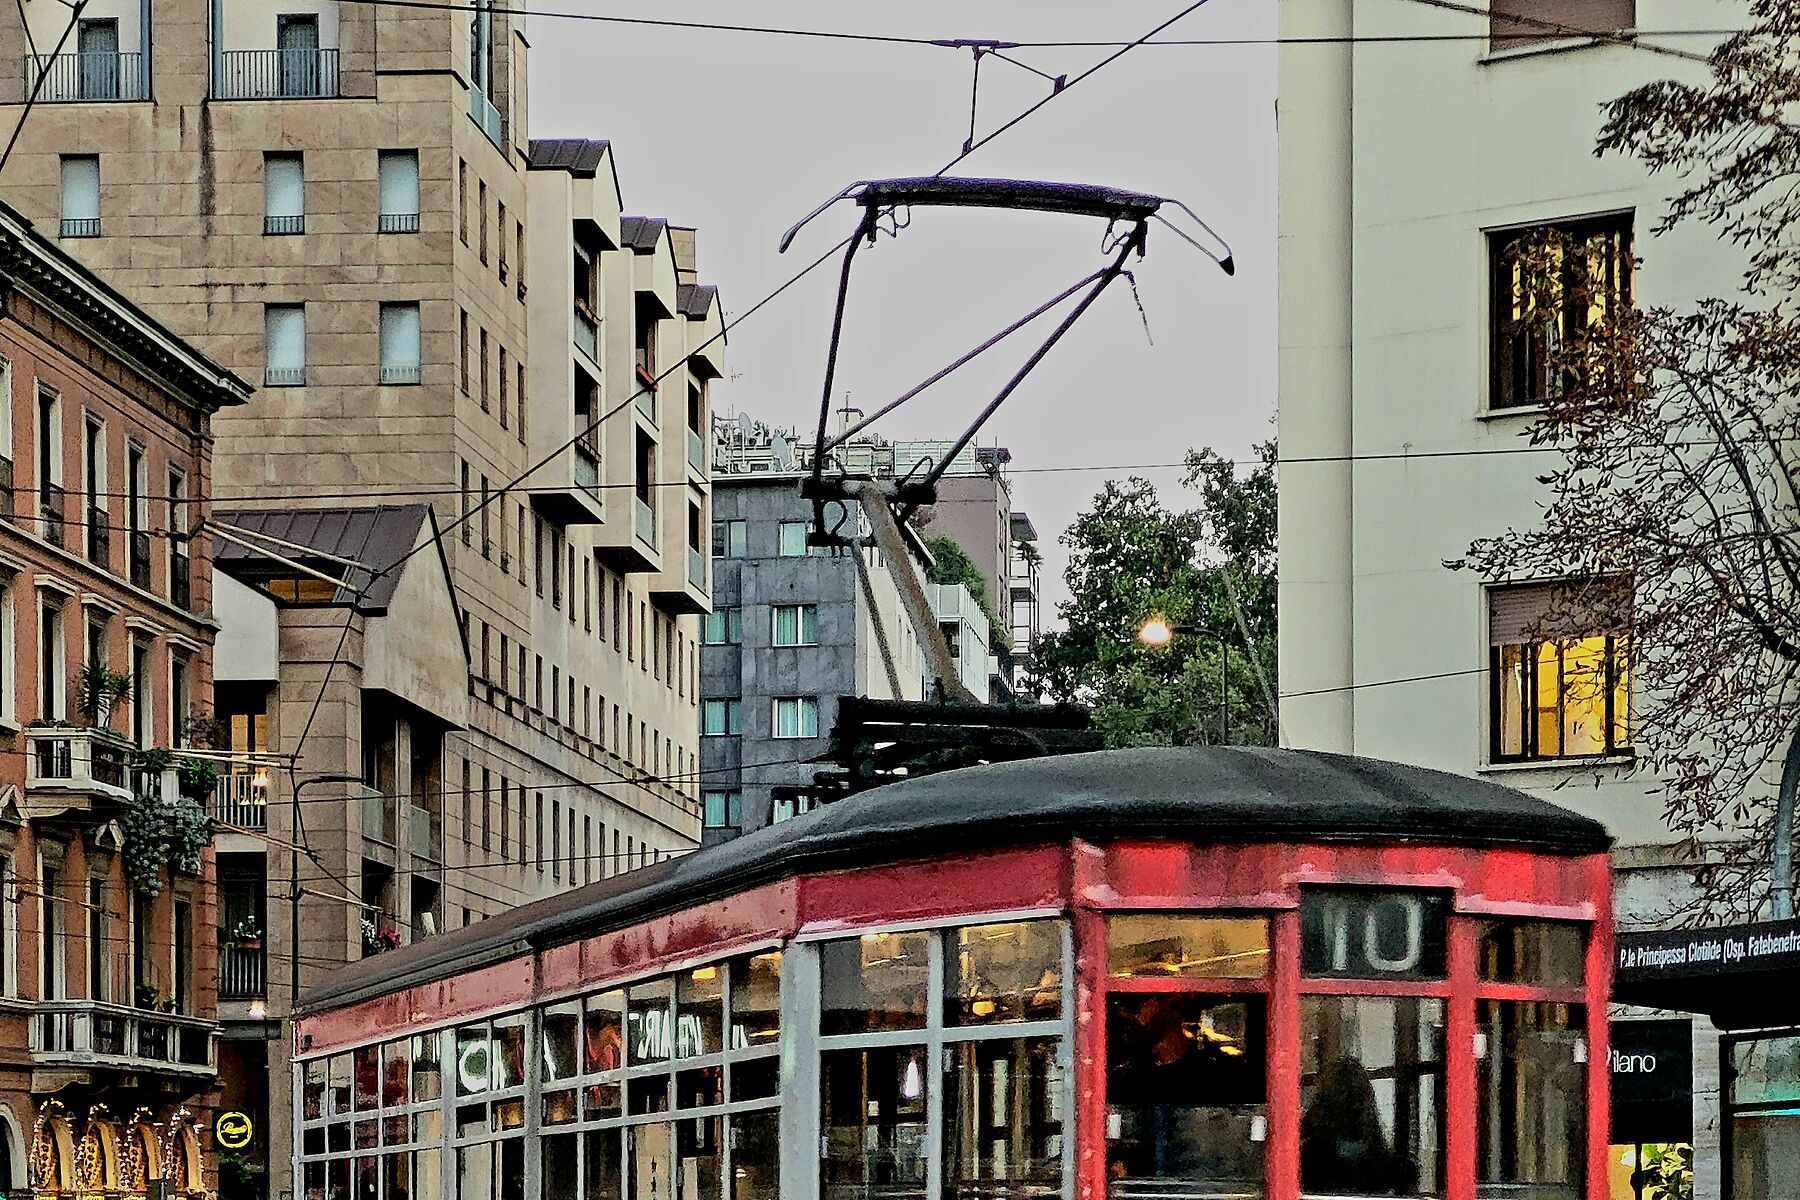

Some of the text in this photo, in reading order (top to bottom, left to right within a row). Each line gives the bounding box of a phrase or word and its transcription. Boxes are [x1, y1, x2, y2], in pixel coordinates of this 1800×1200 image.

[1322, 893, 1423, 972] 10
[1620, 949, 1636, 968] P.le
[1637, 946, 1687, 969] Principessa
[1688, 939, 1722, 963] Clotilde
[1723, 936, 1746, 964] (Osp.
[1607, 1048, 1656, 1073] ilano
